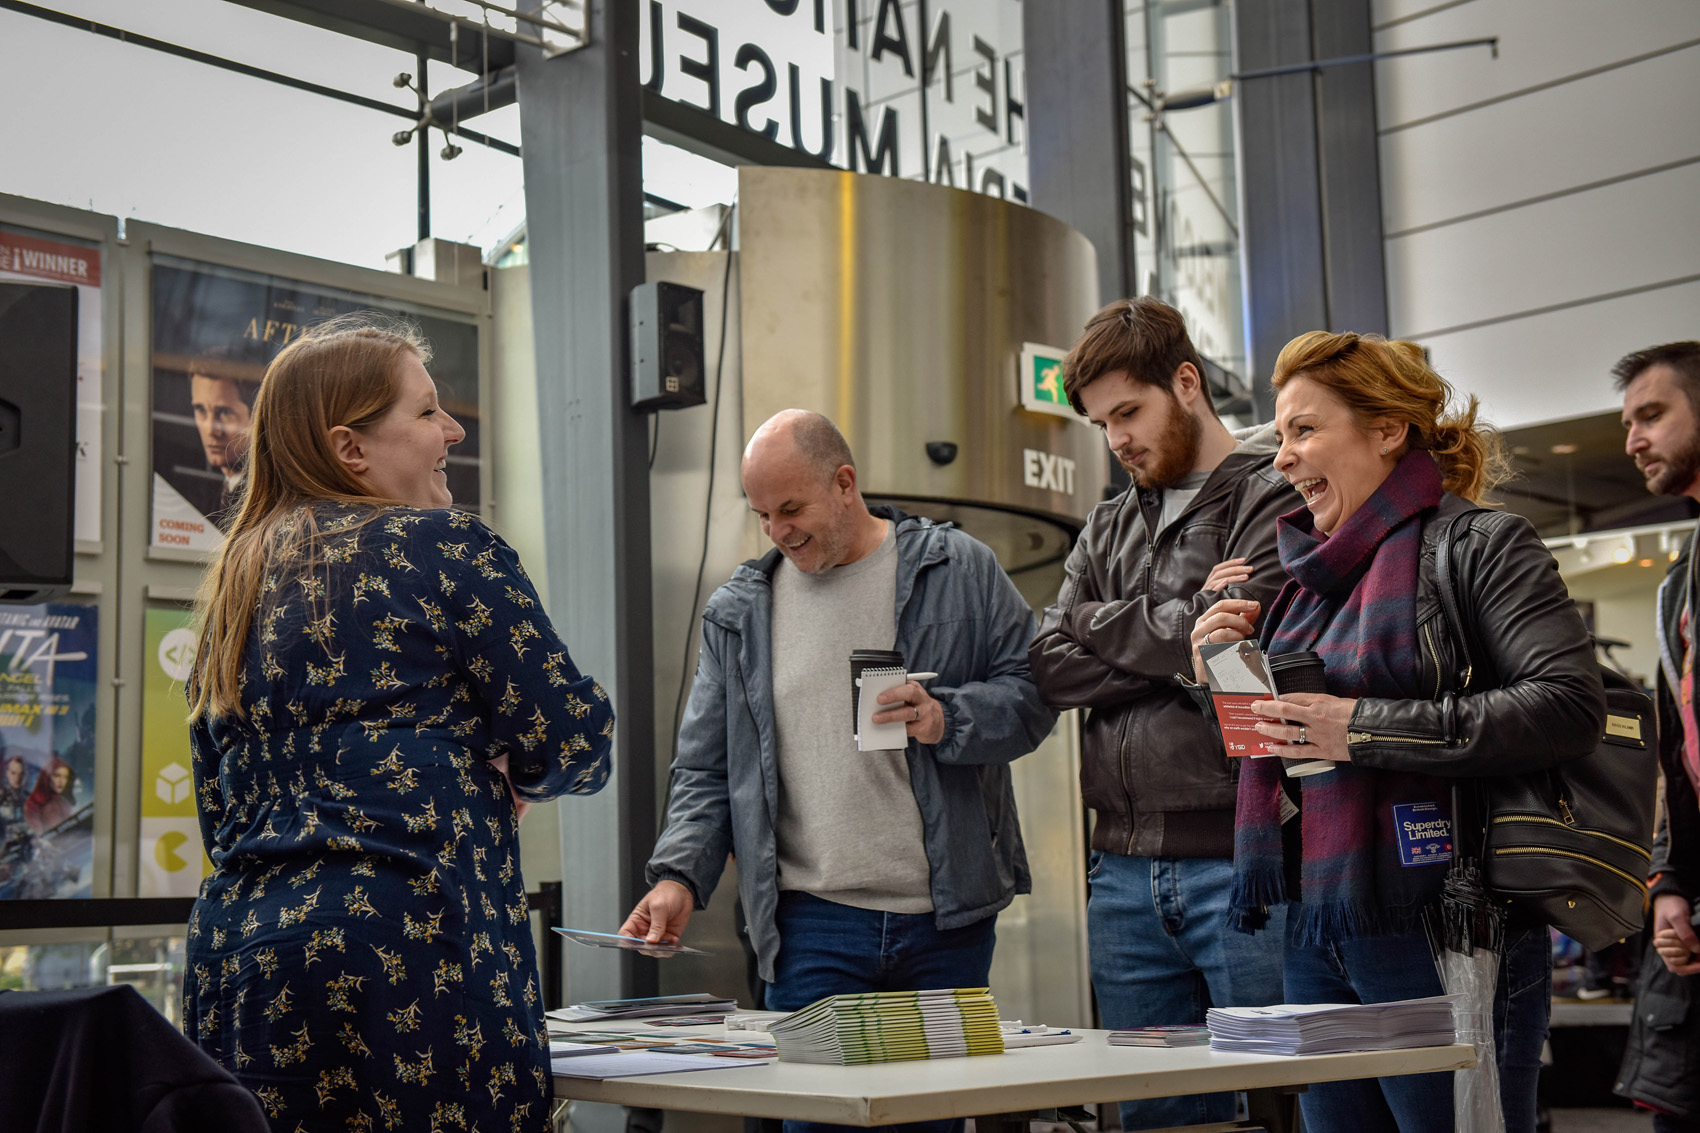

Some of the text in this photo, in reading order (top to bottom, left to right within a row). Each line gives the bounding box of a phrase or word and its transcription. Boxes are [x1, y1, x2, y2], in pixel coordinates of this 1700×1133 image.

[22, 248, 88, 278] WINNER
[1023, 448, 1076, 495] EXIT
[159, 518, 205, 534] COMING
[158, 533, 190, 545] SOON
[0, 629, 88, 687] ITA
[0, 672, 43, 685] NGEL
[1403, 819, 1451, 832] Superdry
[1408, 828, 1450, 840] Limited.
